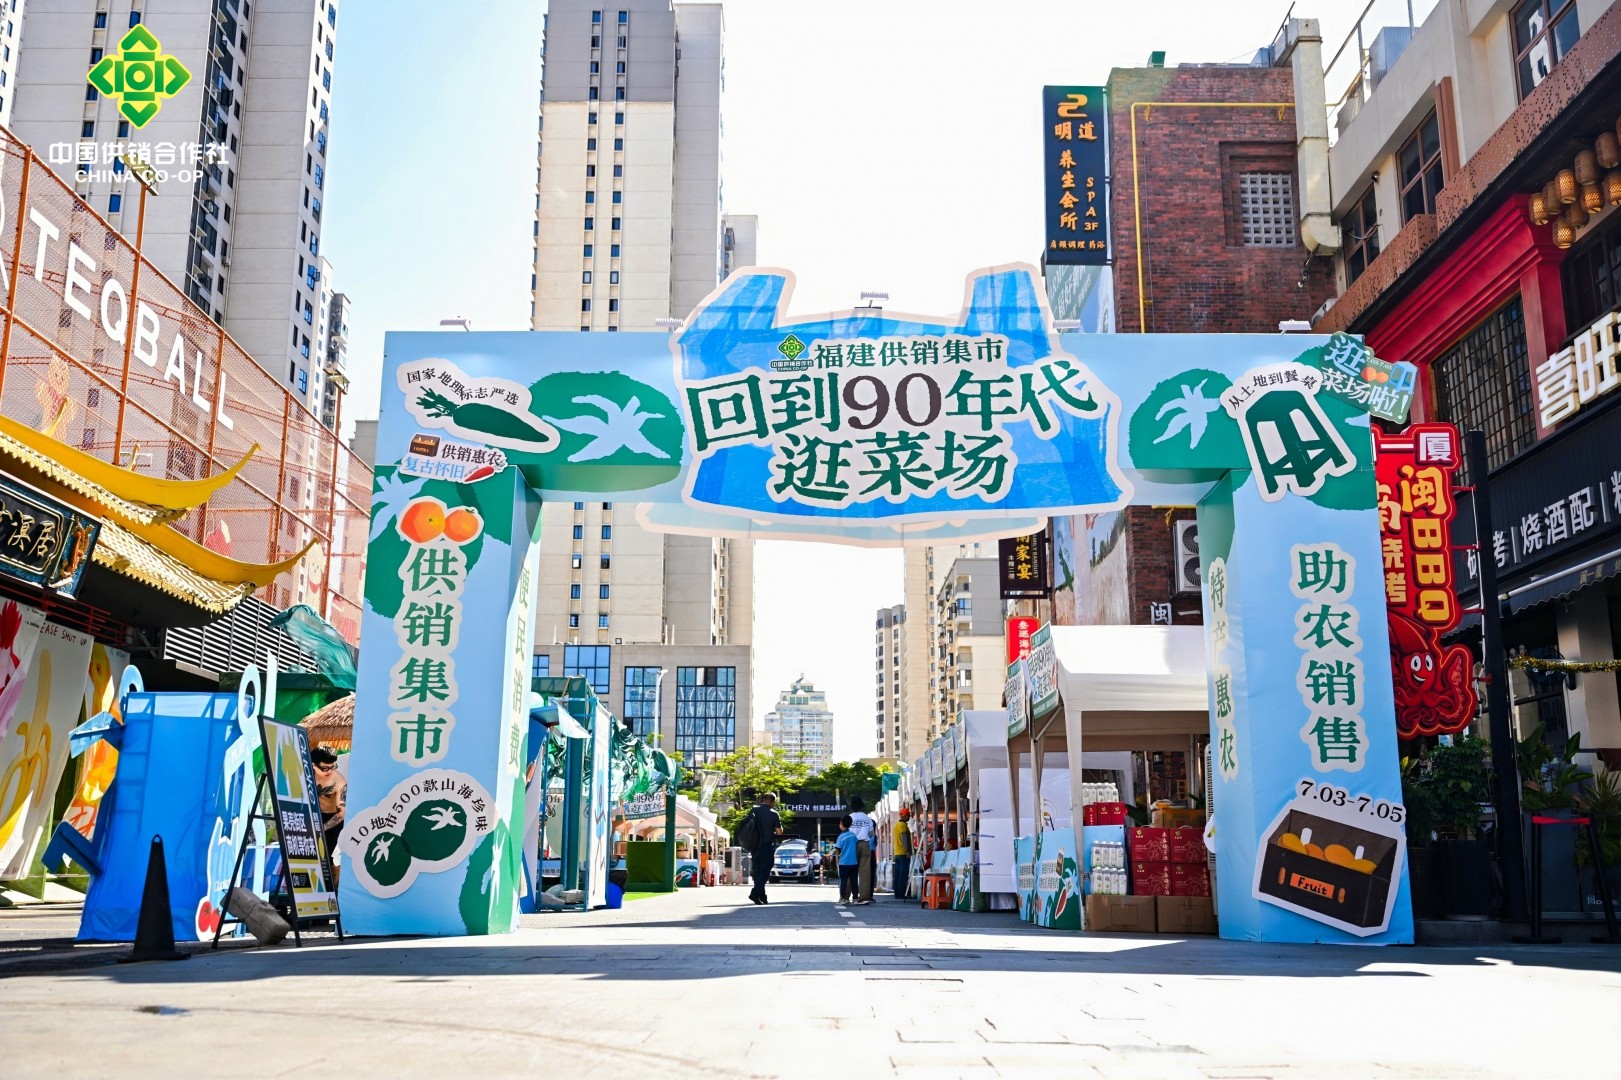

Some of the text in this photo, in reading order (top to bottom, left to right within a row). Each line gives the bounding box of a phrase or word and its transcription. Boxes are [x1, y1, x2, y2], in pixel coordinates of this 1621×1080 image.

[1058, 149, 1079, 231] 养生会所
[29, 206, 234, 431] TEQBALL
[813, 337, 1003, 370] 福建供销集市
[1324, 334, 1371, 377] 逛
[1536, 312, 1621, 429] 喜旺
[406, 367, 520, 407] 国家地理标志严选
[685, 359, 1098, 453] 回到90年代
[1228, 370, 1318, 410] 从土地到餐桌
[403, 456, 466, 480] 复古怀旧
[441, 443, 502, 466] 供销惠农
[773, 431, 1009, 499] 逛菜场
[1372, 432, 1452, 461] 一厦
[61, 629, 77, 643] SHUT
[80, 637, 88, 646] UP
[394, 547, 461, 761] 供销集市
[1297, 549, 1361, 764] 助农销售
[1209, 566, 1237, 773] 特产惠农
[349, 777, 489, 847] 10地市500款山海珍味
[1300, 779, 1404, 823] 7.03-7.05
